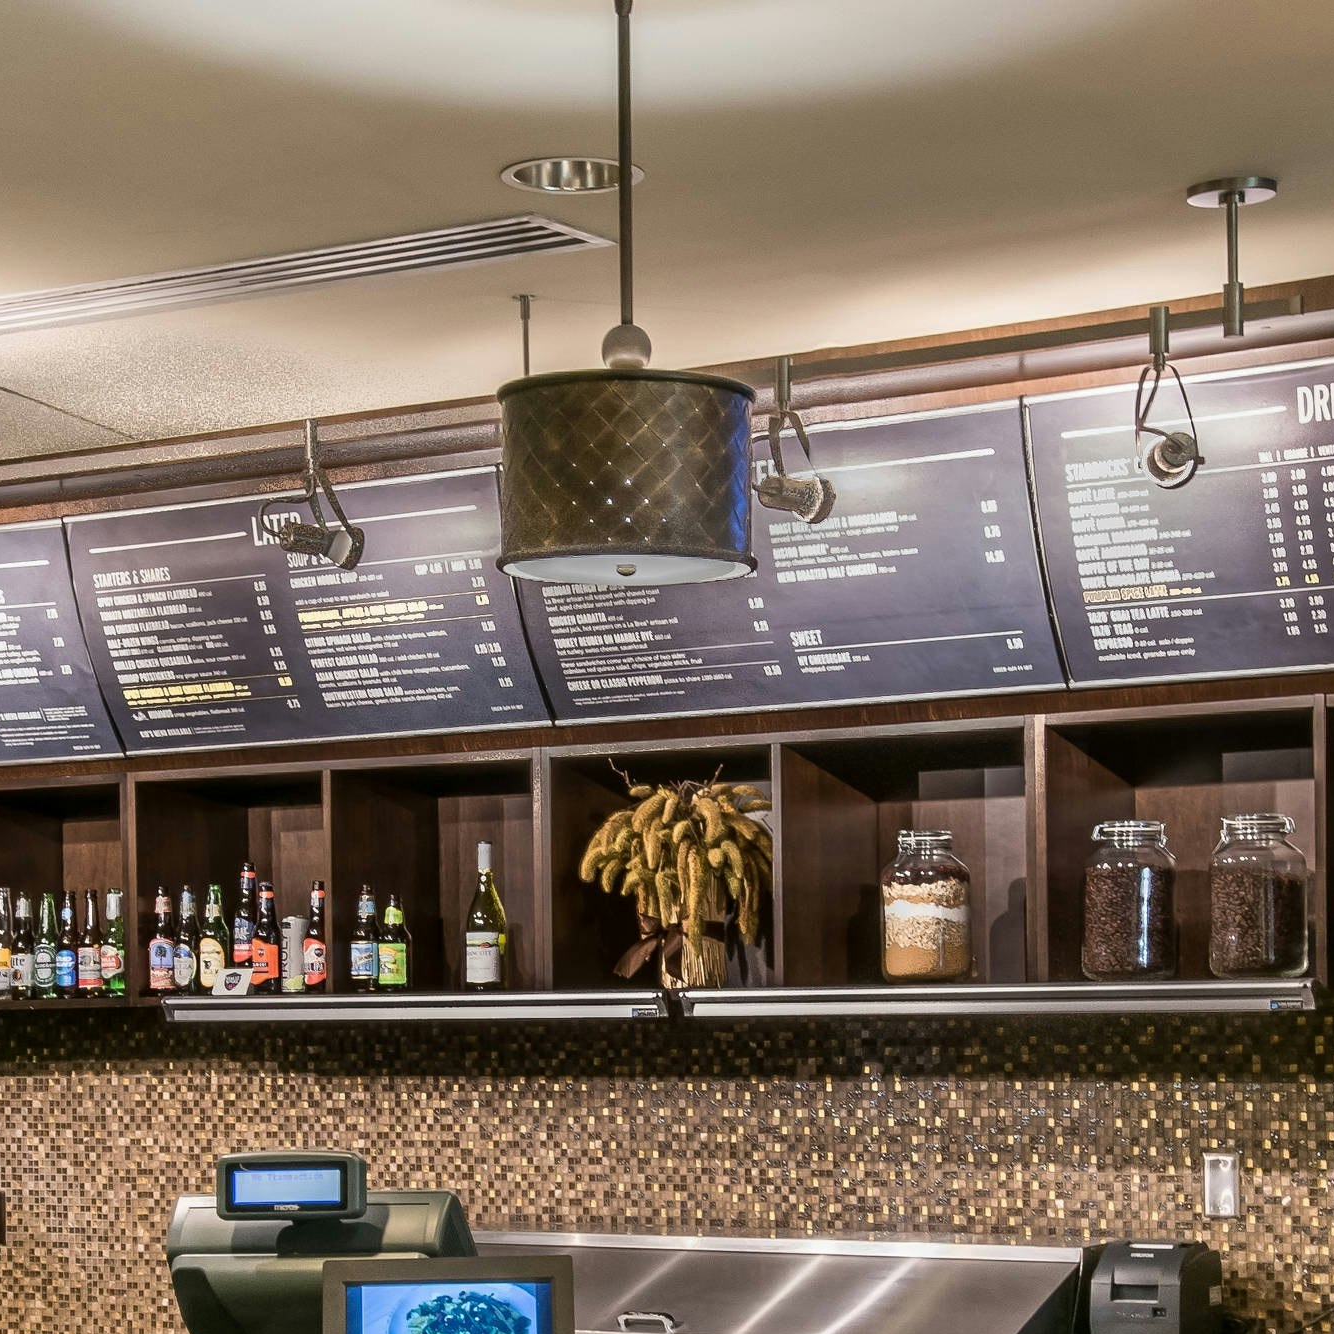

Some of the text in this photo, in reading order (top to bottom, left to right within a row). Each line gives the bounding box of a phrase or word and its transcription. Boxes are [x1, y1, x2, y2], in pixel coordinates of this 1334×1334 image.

[287, 552, 308, 567] SOUP
[93, 567, 170, 588] STARTERS & SHARES
[290, 572, 357, 588] CHICKEN NOODLE SOUP
[790, 629, 822, 646] SWEET
[1093, 636, 1133, 650] ESPRESSO
[797, 652, 851, 668] NY CHEESECAKE
[567, 674, 663, 691] CHEESE OR CLASSIC PEPPERONI
